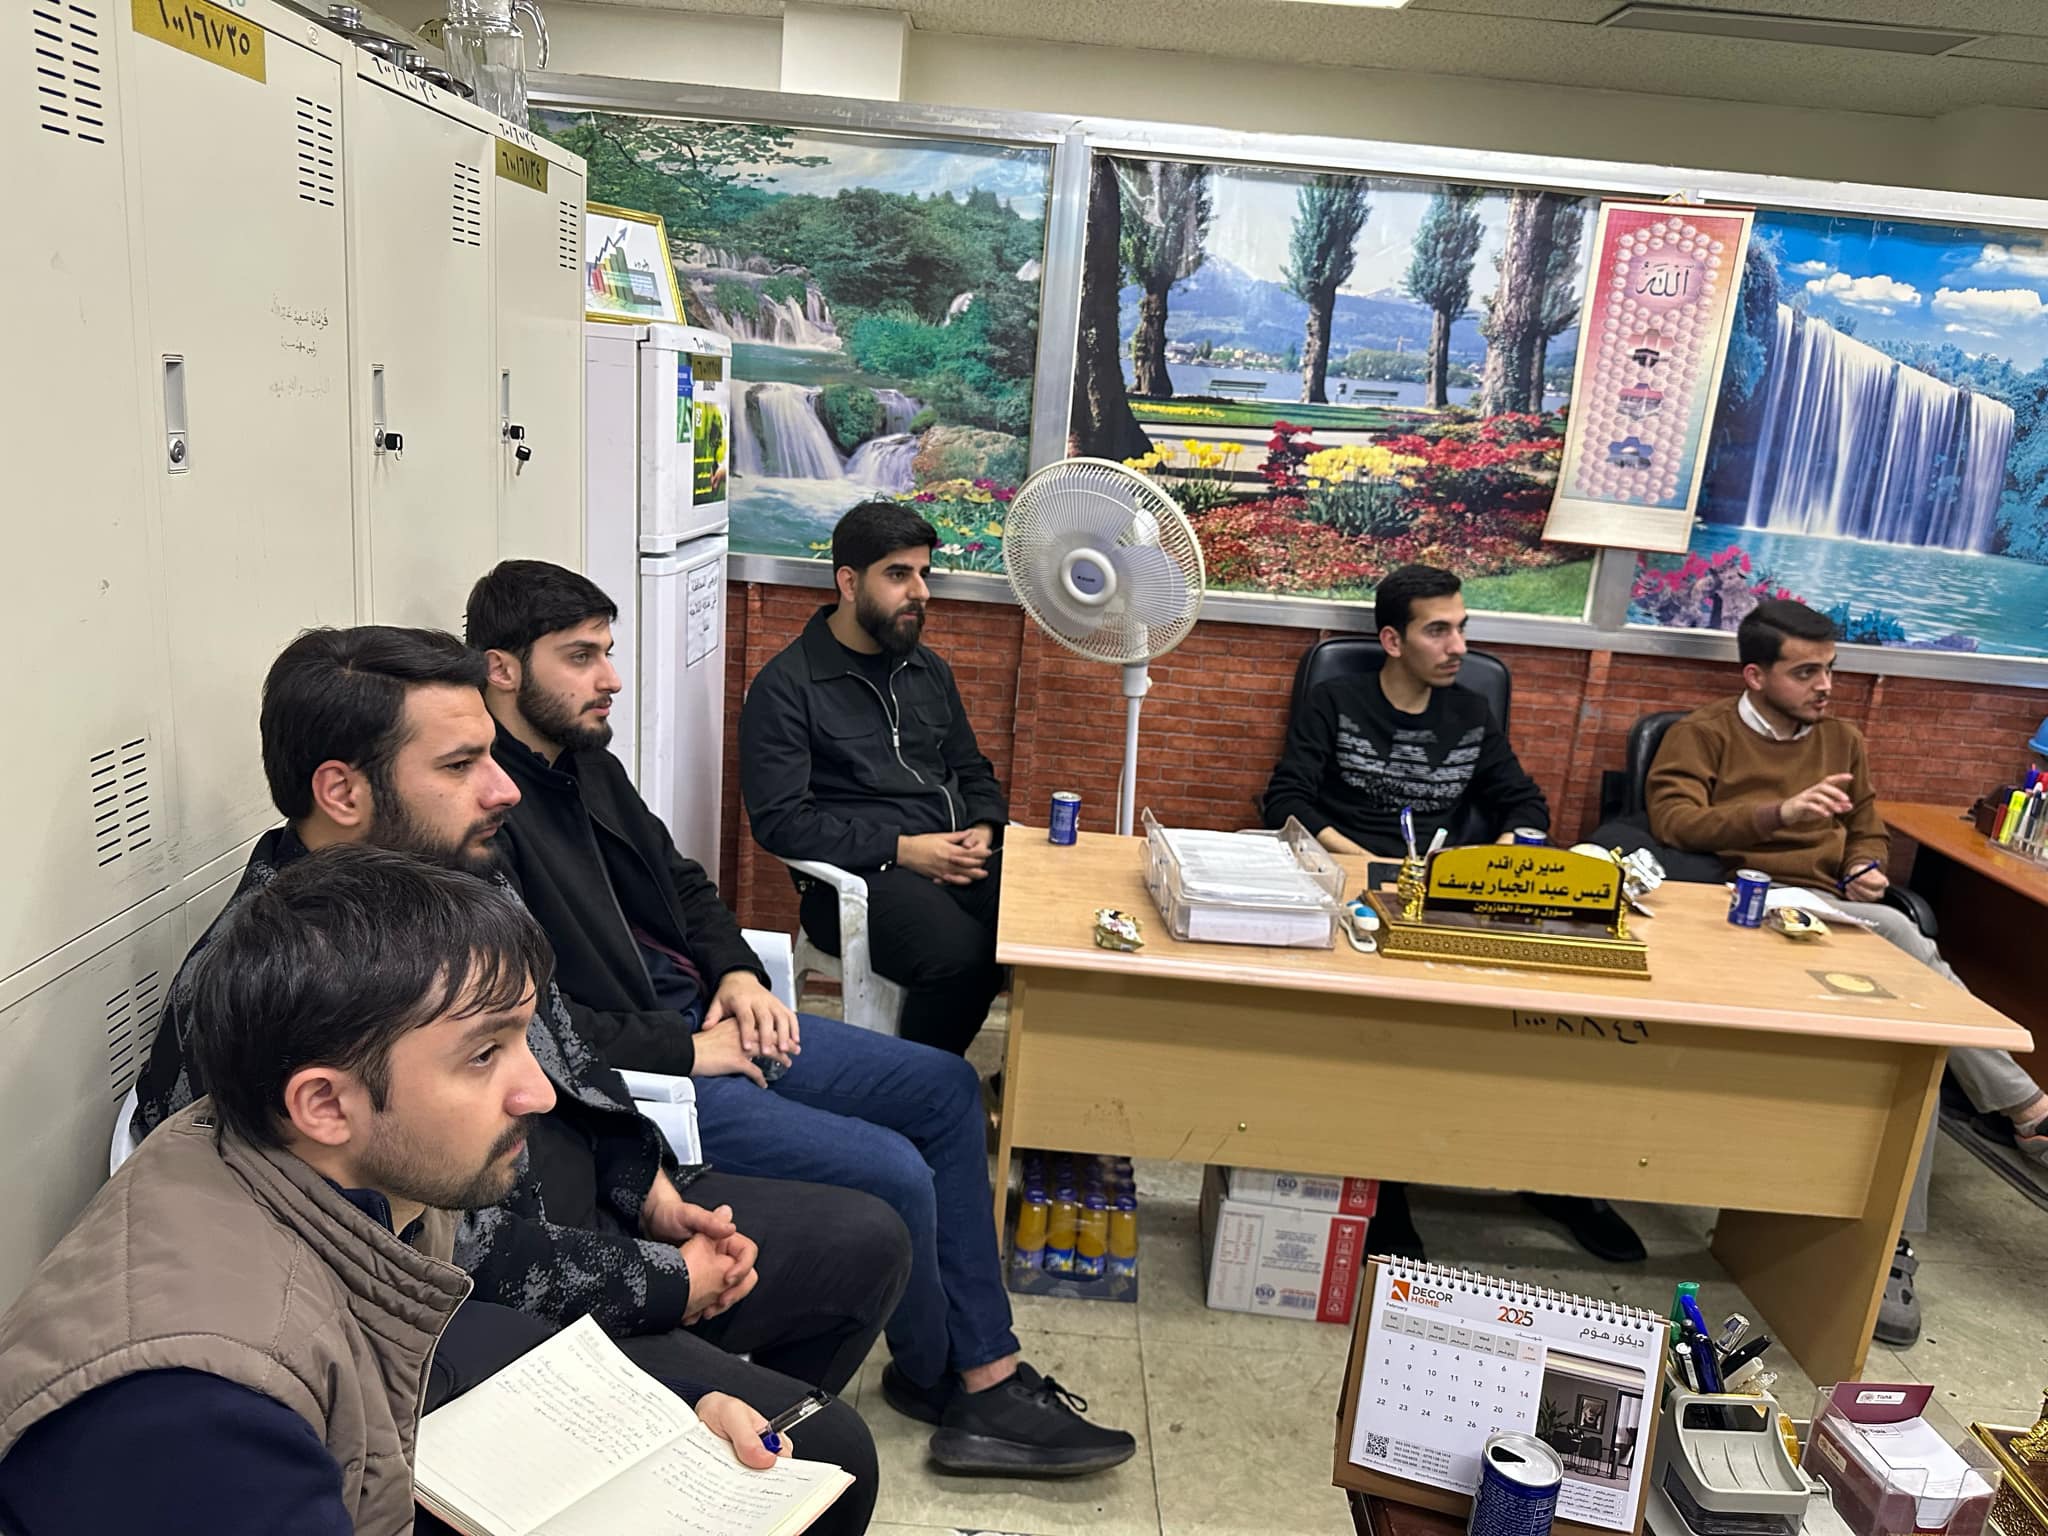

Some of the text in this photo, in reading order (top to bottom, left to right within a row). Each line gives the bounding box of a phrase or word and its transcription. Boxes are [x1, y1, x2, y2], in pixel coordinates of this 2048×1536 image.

[1514, 860, 1535, 879] فني
[1536, 862, 1566, 876] مدير
[1437, 874, 1611, 903] قيس عبد الجبار يوسف
[1276, 1177, 1298, 1189] ISO
[1410, 1296, 1440, 1308] HOME
[1412, 1286, 1453, 1303] DECOR
[1497, 1305, 1534, 1327] 2025
[1428, 1369, 1437, 1377] 10
[1450, 1374, 1459, 1382] 11
[1473, 1380, 1483, 1388] 12
[1497, 1385, 1506, 1393] 13
[1520, 1390, 1529, 1398] 14
[1380, 1377, 1526, 1419] 15 16 17 18 19 20 21
[1376, 1397, 1386, 1405] 22
[1398, 1403, 1408, 1412] 23
[1421, 1409, 1431, 1417] 24
[1443, 1414, 1453, 1423] 25
[1467, 1420, 1477, 1429] 26
